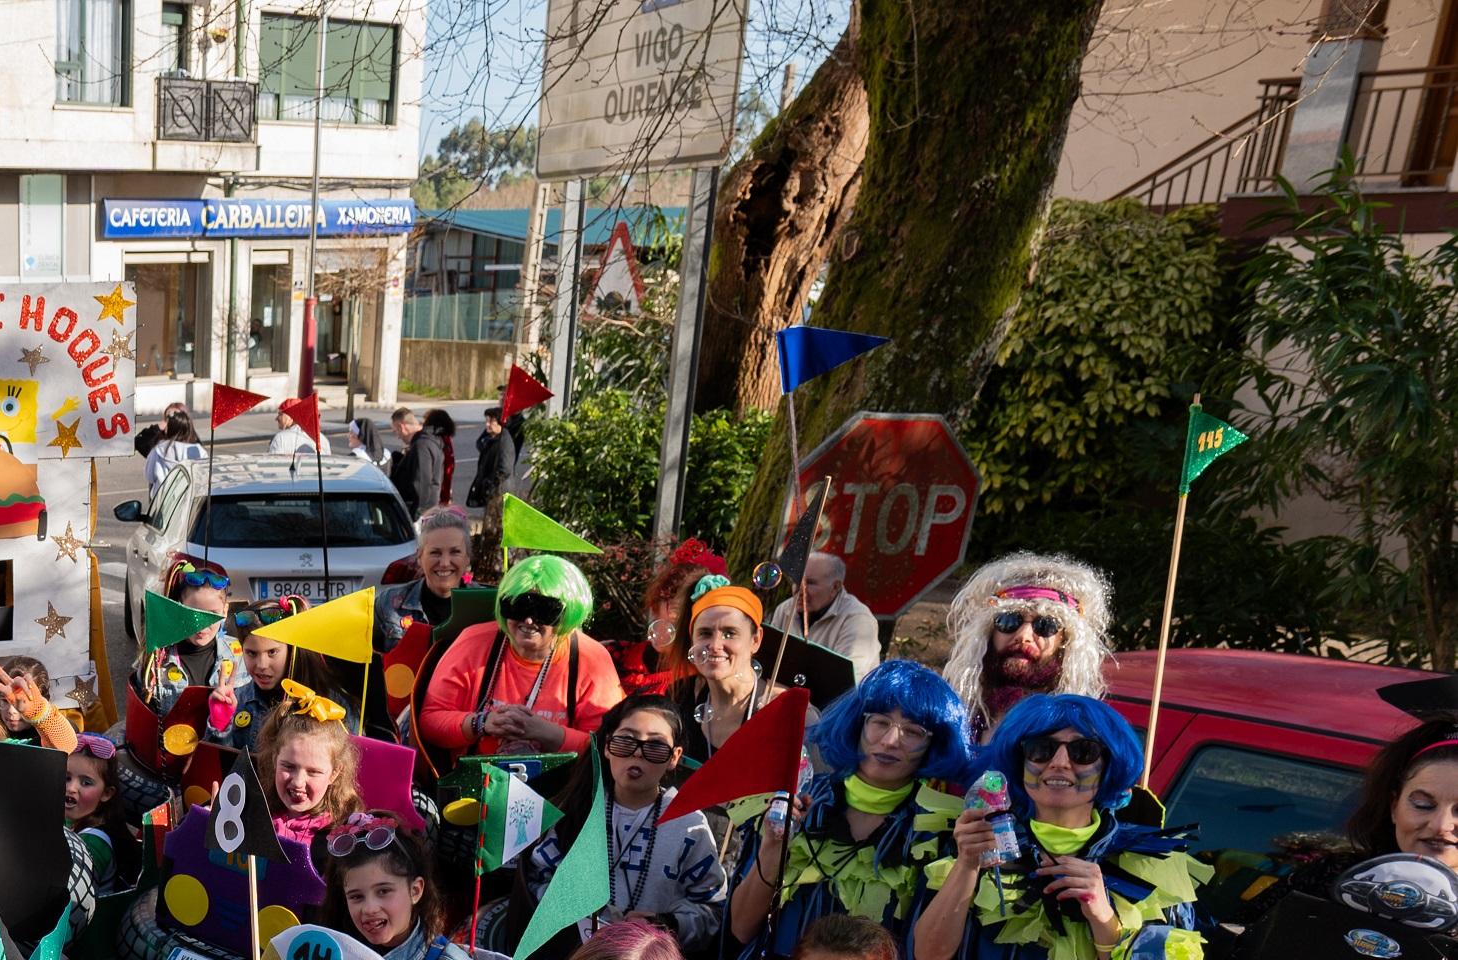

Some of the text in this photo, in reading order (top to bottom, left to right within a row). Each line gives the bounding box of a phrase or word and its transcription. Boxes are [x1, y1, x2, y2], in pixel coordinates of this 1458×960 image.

[635, 23, 684, 68] VIGO
[604, 69, 703, 124] OURENSE
[110, 204, 412, 230] CAFETERIA CARBALLEIRA XAMONERIA
[273, 582, 347, 598] 9848 HTR
[215, 772, 246, 853] 8
